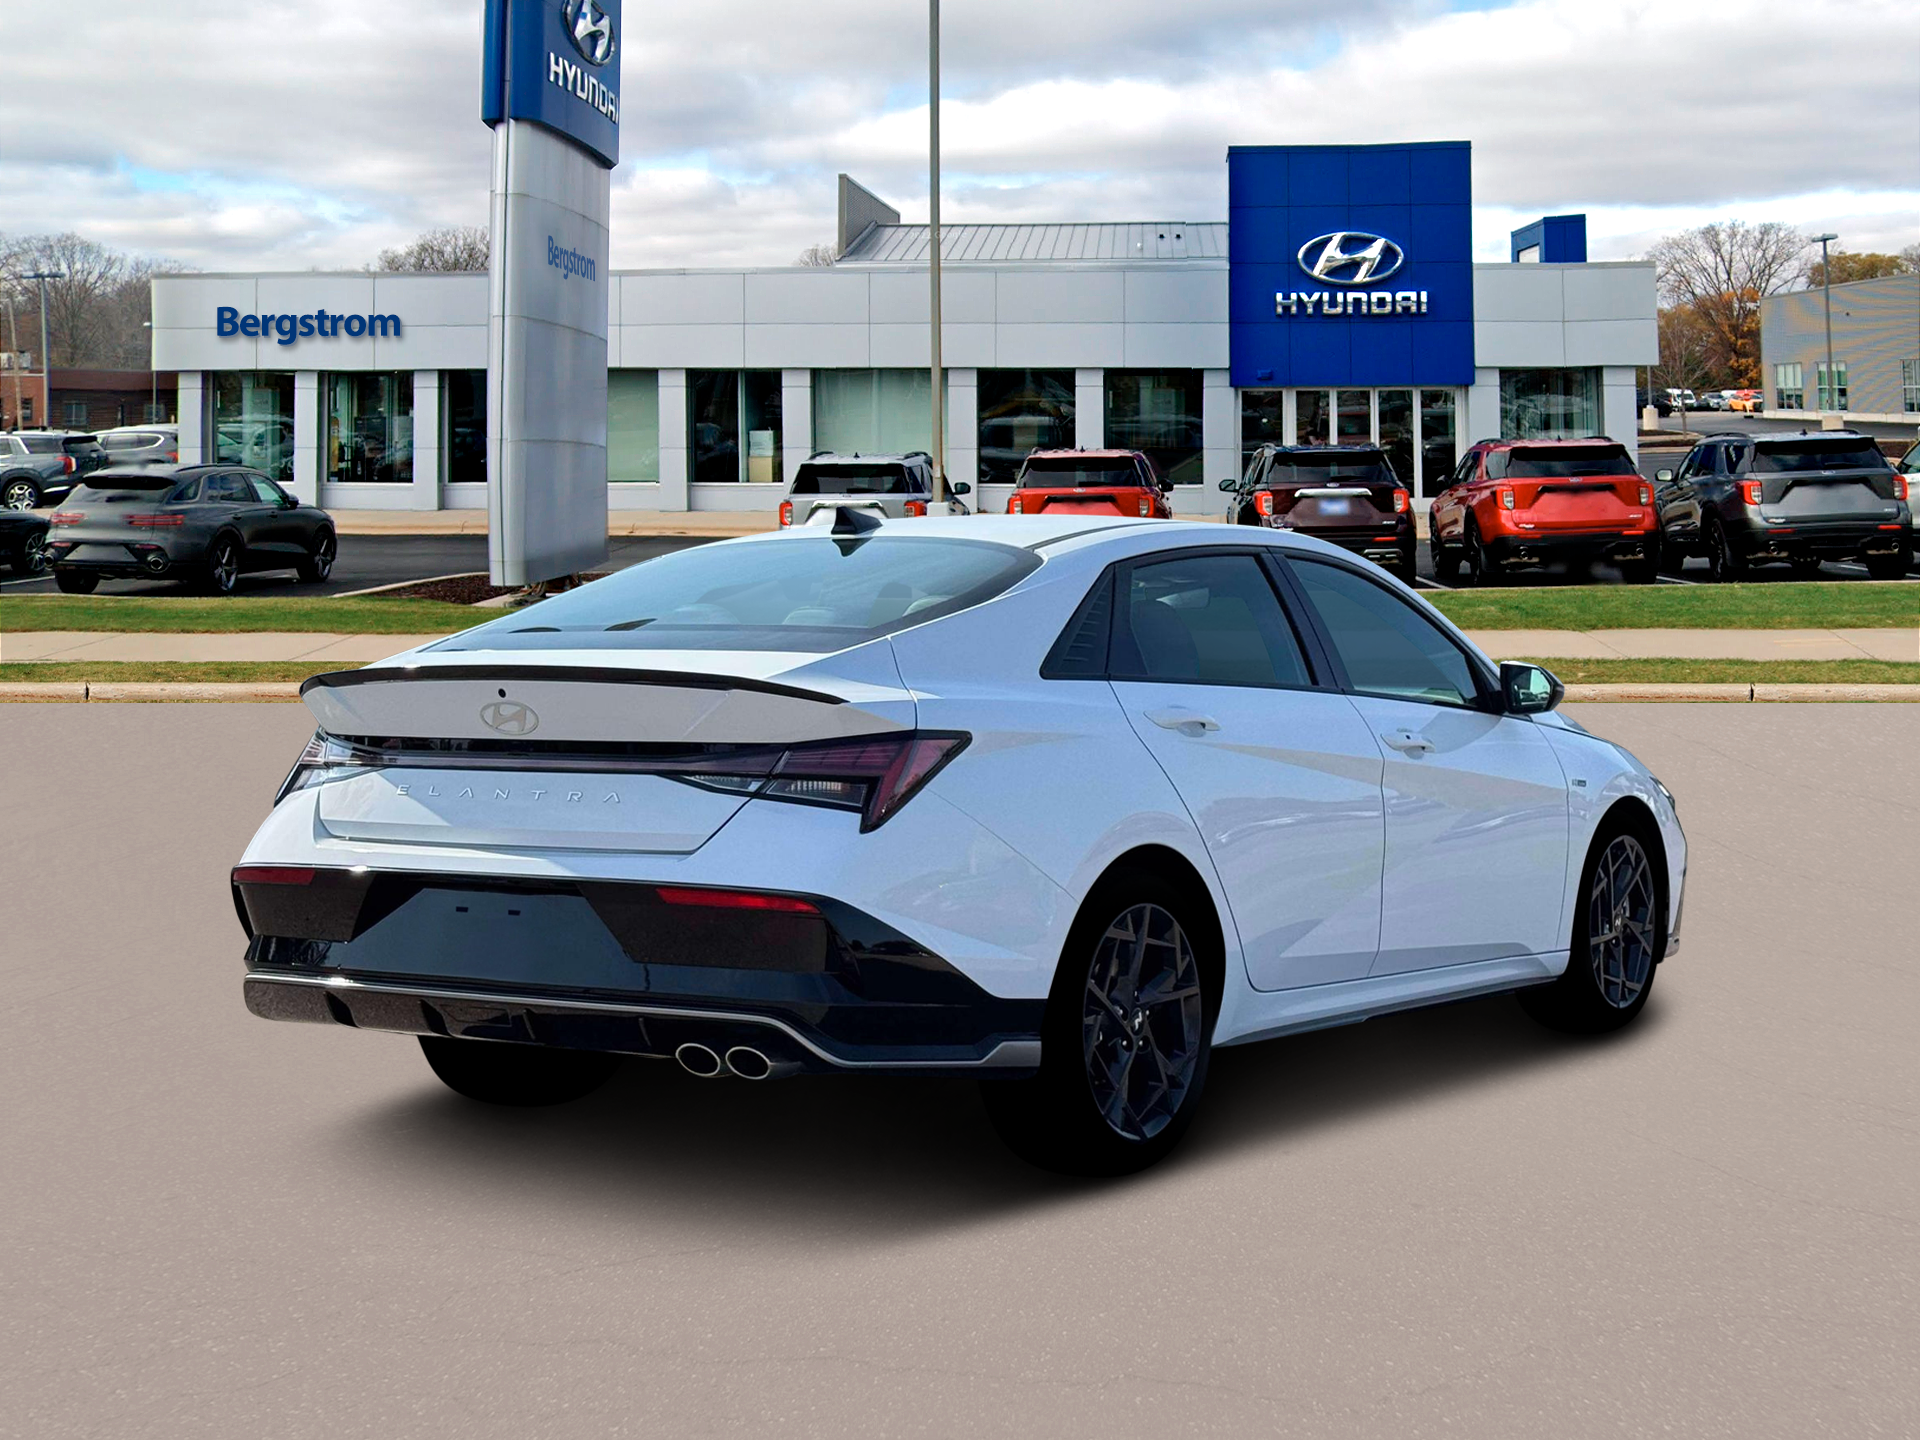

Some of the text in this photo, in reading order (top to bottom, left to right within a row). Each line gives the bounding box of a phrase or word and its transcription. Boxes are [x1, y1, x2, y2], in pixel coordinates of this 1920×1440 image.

[549, 51, 619, 124] HYUNDAI
[548, 235, 596, 282] Bergstrom
[1275, 291, 1428, 315] HYUNDAI
[216, 306, 401, 346] Bergstrom
[396, 784, 621, 803] ELANTRA
